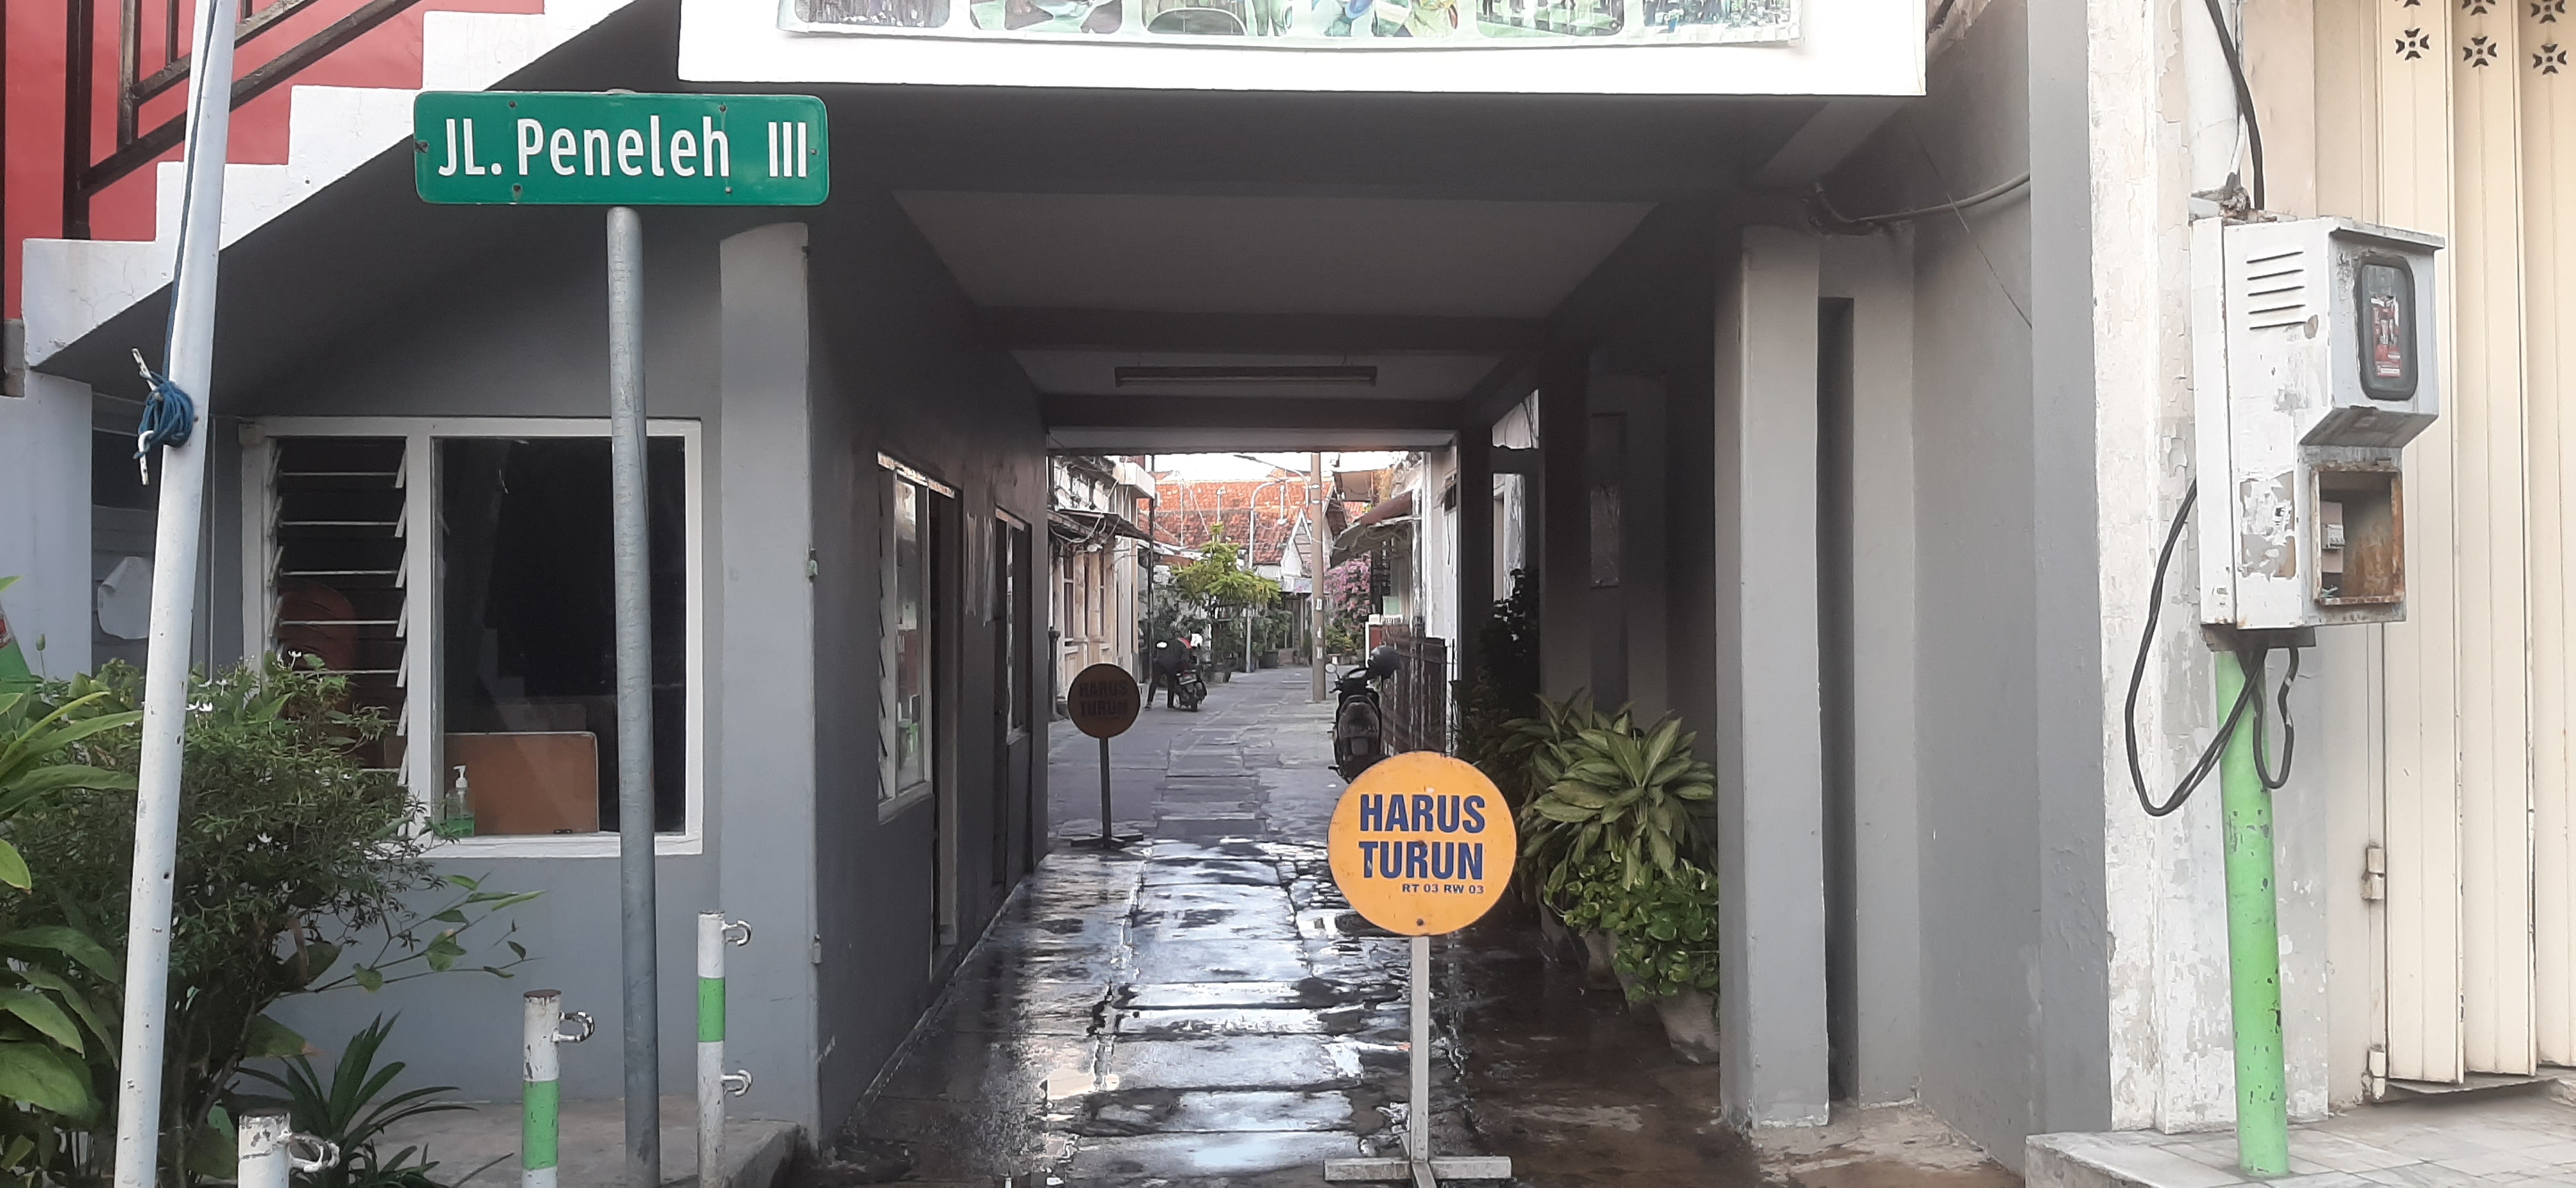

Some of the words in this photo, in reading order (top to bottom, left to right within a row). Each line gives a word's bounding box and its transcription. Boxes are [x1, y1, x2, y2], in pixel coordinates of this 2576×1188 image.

[438, 118, 502, 176] JL.
[517, 115, 730, 177] Peneleh
[768, 121, 808, 178] III
[1079, 680, 1128, 697] HARUS
[1079, 699, 1128, 716] TURUN
[1360, 794, 1485, 834] HARUS
[1358, 841, 1483, 880] TURUN
[1402, 883, 1420, 893] RT
[1423, 883, 1439, 893] 03
[1444, 884, 1464, 894] RW
[1468, 885, 1485, 894] 03
